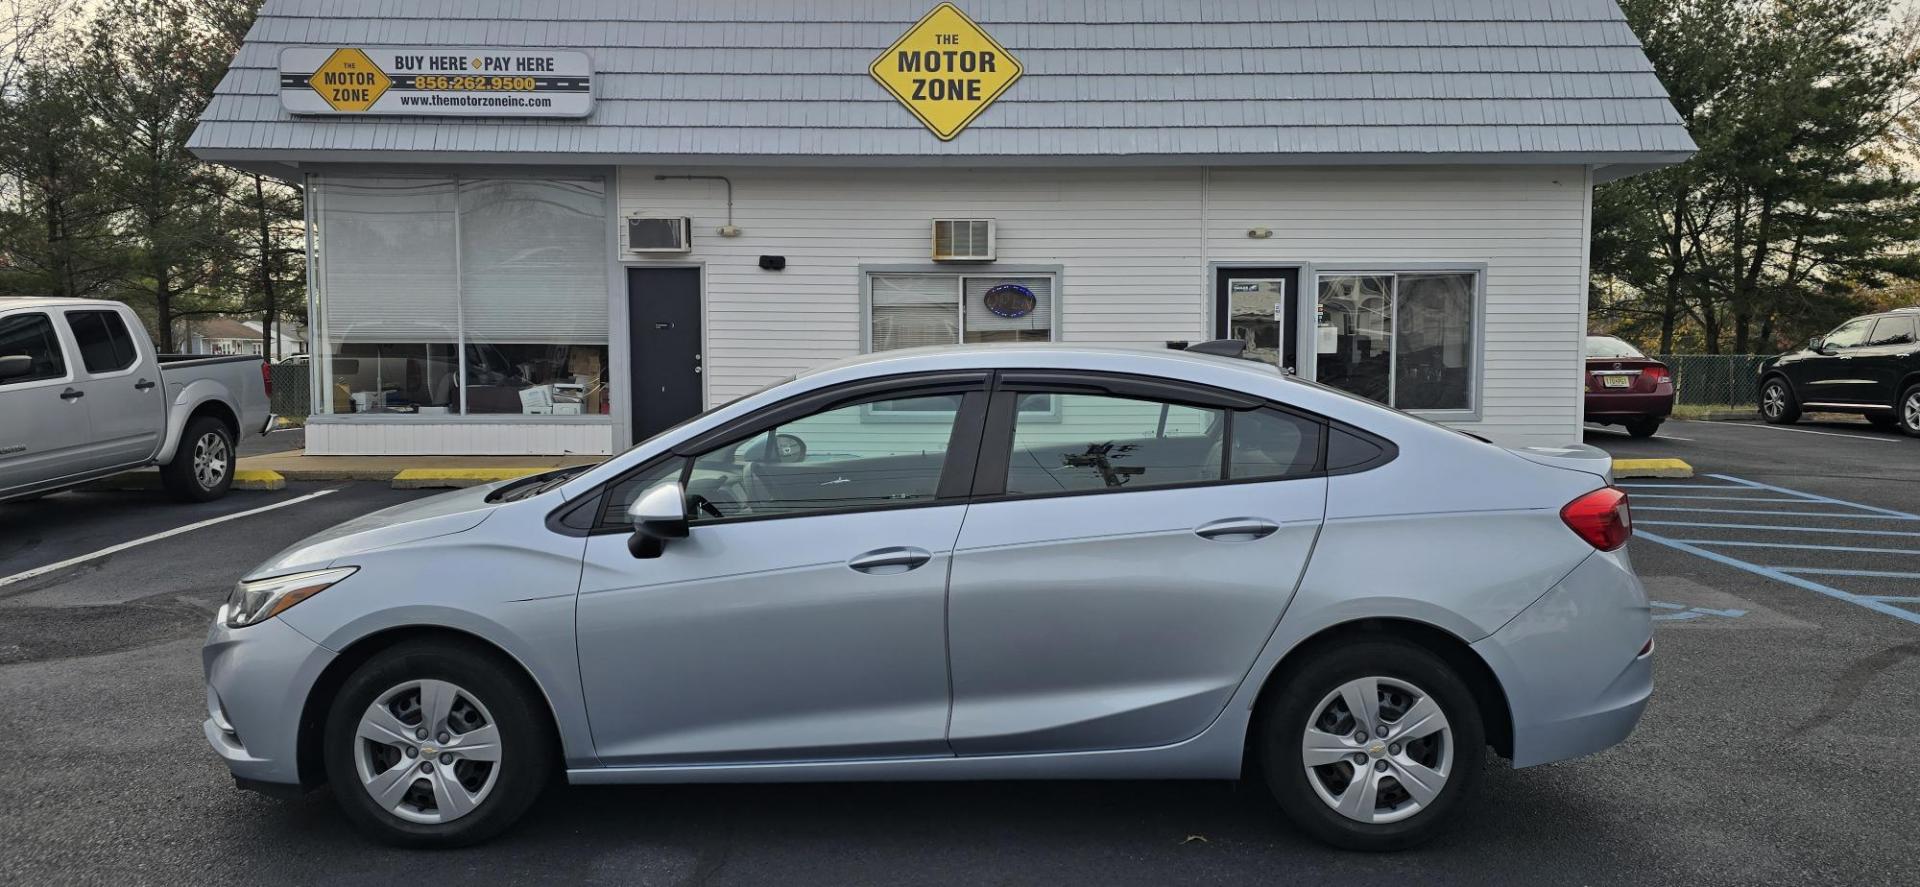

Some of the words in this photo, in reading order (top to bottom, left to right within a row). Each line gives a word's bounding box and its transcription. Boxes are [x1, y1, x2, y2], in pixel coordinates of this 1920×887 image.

[935, 34, 959, 45] THE
[395, 55, 424, 70] BUY
[429, 56, 467, 71] HERE
[484, 56, 511, 72] PAY
[516, 57, 554, 72] HERE
[898, 50, 996, 73] MOTOR
[324, 71, 375, 86] MOTOR
[415, 75, 536, 91] 856.262.9500
[332, 88, 369, 103] ZONE
[912, 78, 981, 101] ZONE
[401, 93, 551, 108] www.themotorzoneinc.com
